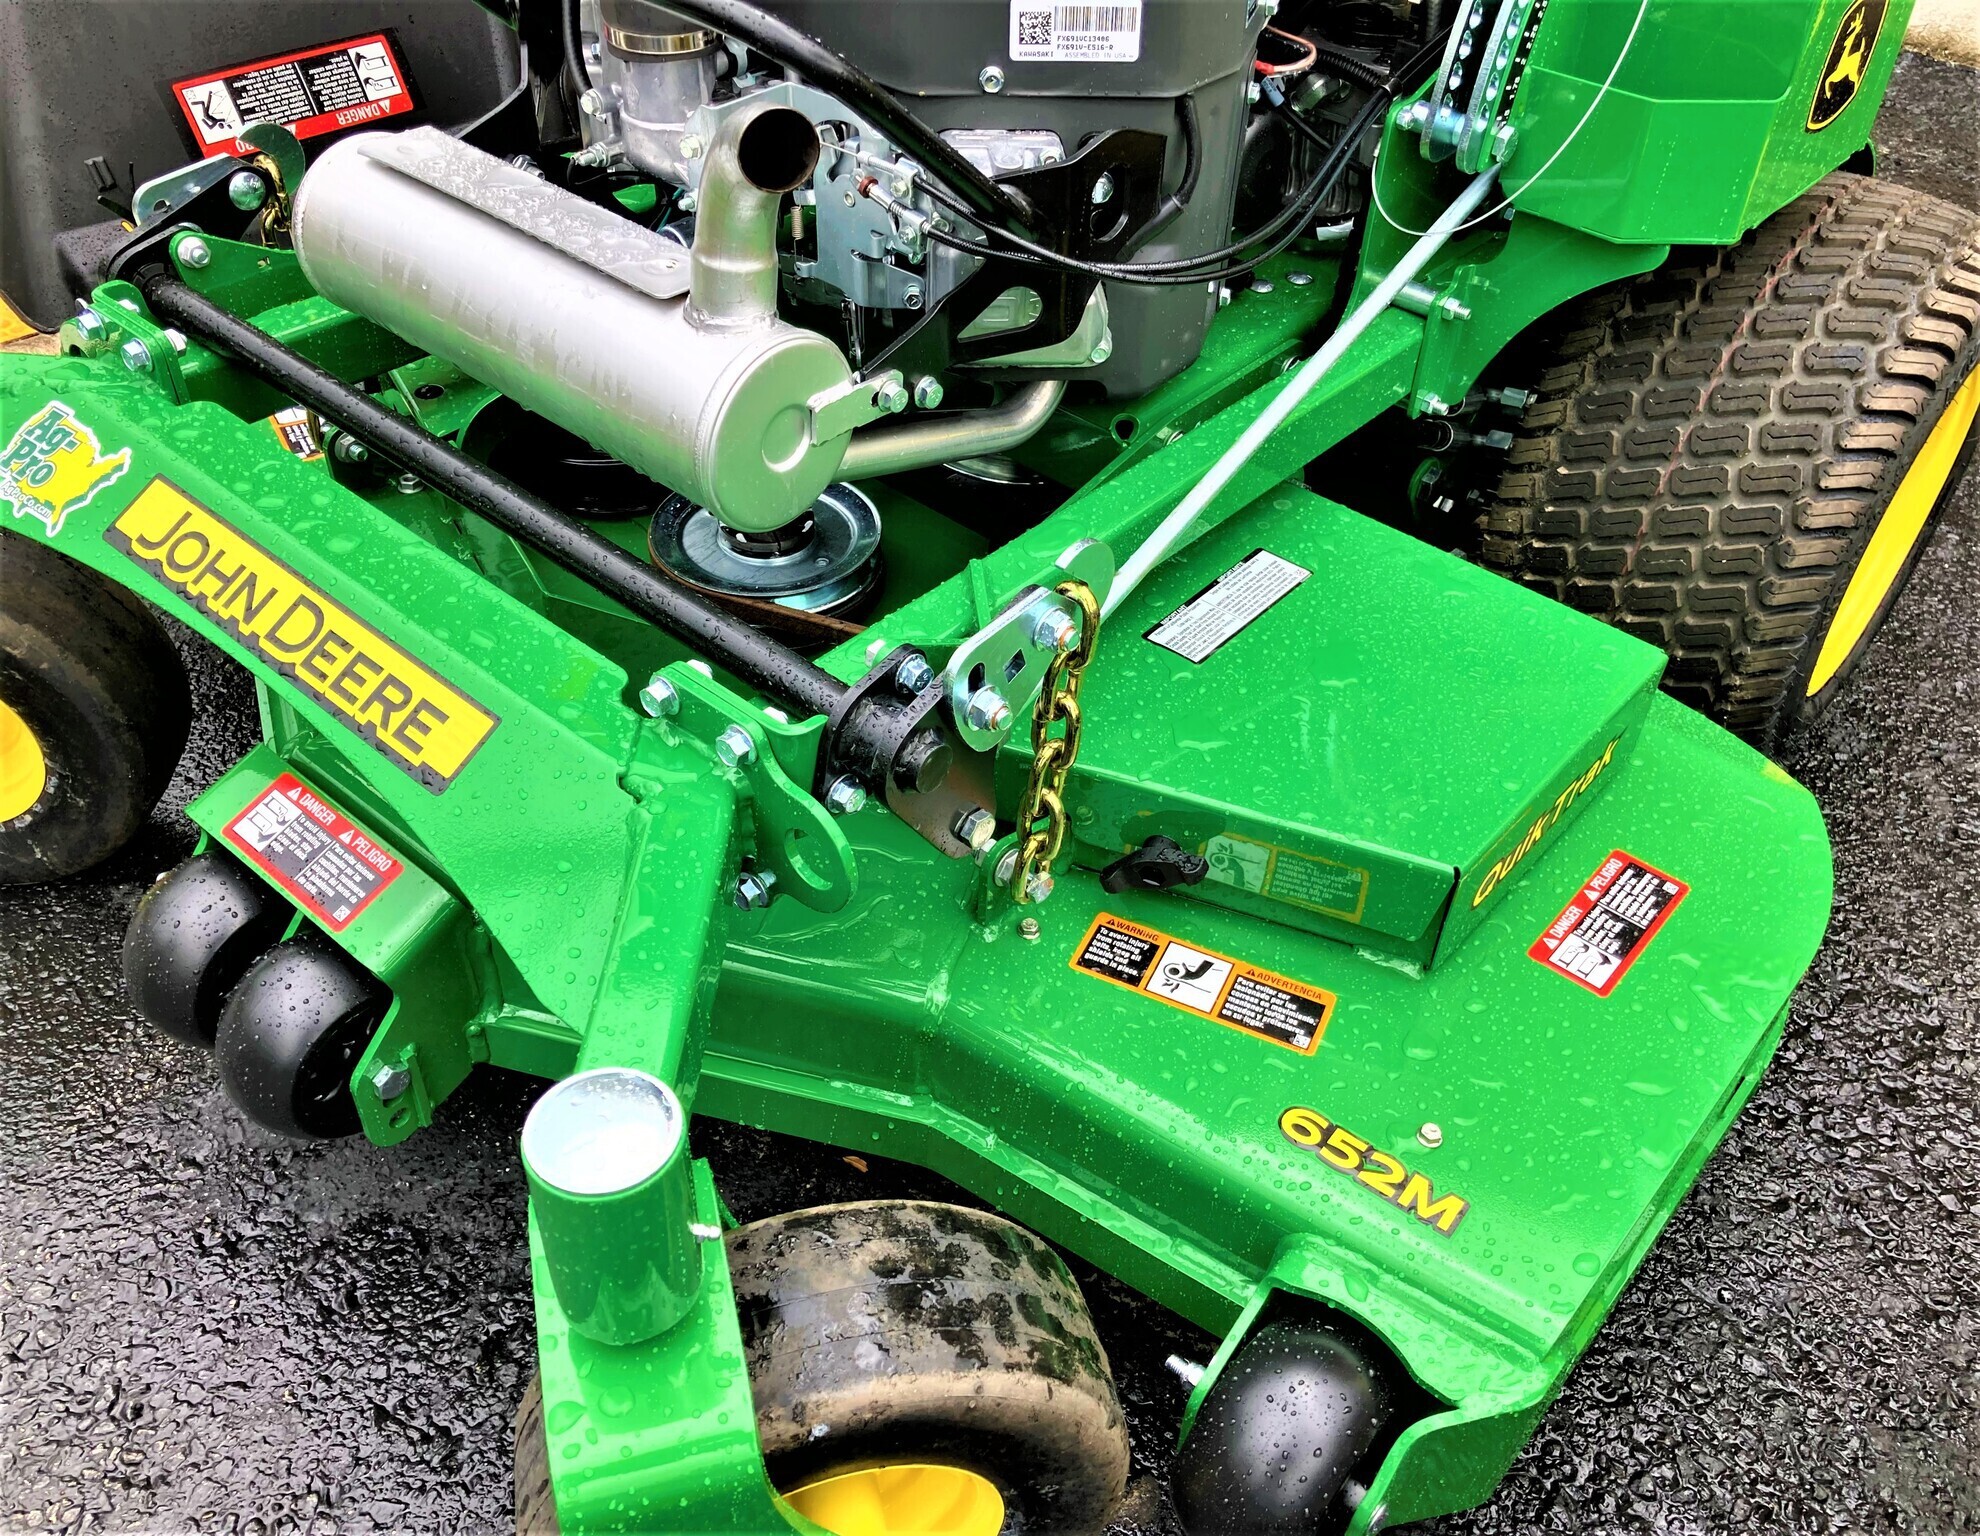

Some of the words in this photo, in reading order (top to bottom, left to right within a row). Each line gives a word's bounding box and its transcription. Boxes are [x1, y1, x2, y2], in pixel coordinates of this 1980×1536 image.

[335, 103, 380, 125] DANGER
[23, 408, 80, 456] Ag-
[0, 437, 57, 487] Pro
[1, 480, 52, 519] AgProCo.com
[135, 511, 277, 626] JOHN
[263, 593, 450, 757] DEERE
[298, 793, 336, 825] DANGER
[351, 836, 392, 871] PELIGRO
[1589, 858, 1623, 890] PELIGRO
[1116, 921, 1159, 941] WARNING
[1549, 905, 1582, 938] DANGER
[1094, 933, 1112, 944] from
[1112, 940, 1140, 955] rotating
[1098, 926, 1108, 935] To
[1108, 931, 1129, 943] avoid
[1128, 937, 1149, 950] injury
[1112, 946, 1130, 958] keep
[1084, 952, 1109, 965] guards
[1109, 960, 1117, 968] in
[1116, 964, 1138, 976] place.
[1088, 946, 1113, 959] shields
[1113, 955, 1129, 964] and
[1230, 989, 1259, 1004] correas
[1259, 1000, 1272, 1008] en
[1233, 982, 1270, 1001] lesionado
[1270, 997, 1284, 1005] por
[1284, 1000, 1297, 1010] las
[1236, 976, 1254, 988] Para
[1255, 984, 1277, 996] evitar
[1277, 992, 1291, 1000] ser
[1256, 972, 1321, 1000] ADVERTENCIA
[1221, 1008, 1232, 1016] en
[1232, 1012, 1243, 1020] su
[1243, 1015, 1264, 1028] lugar.
[1224, 1002, 1256, 1018] escudos
[1261, 1015, 1305, 1037] protectores
[1227, 995, 1264, 1012] mantener
[1264, 1008, 1285, 1021] todos
[1285, 1016, 1298, 1026] los
[1279, 1107, 1466, 1233] 652M
